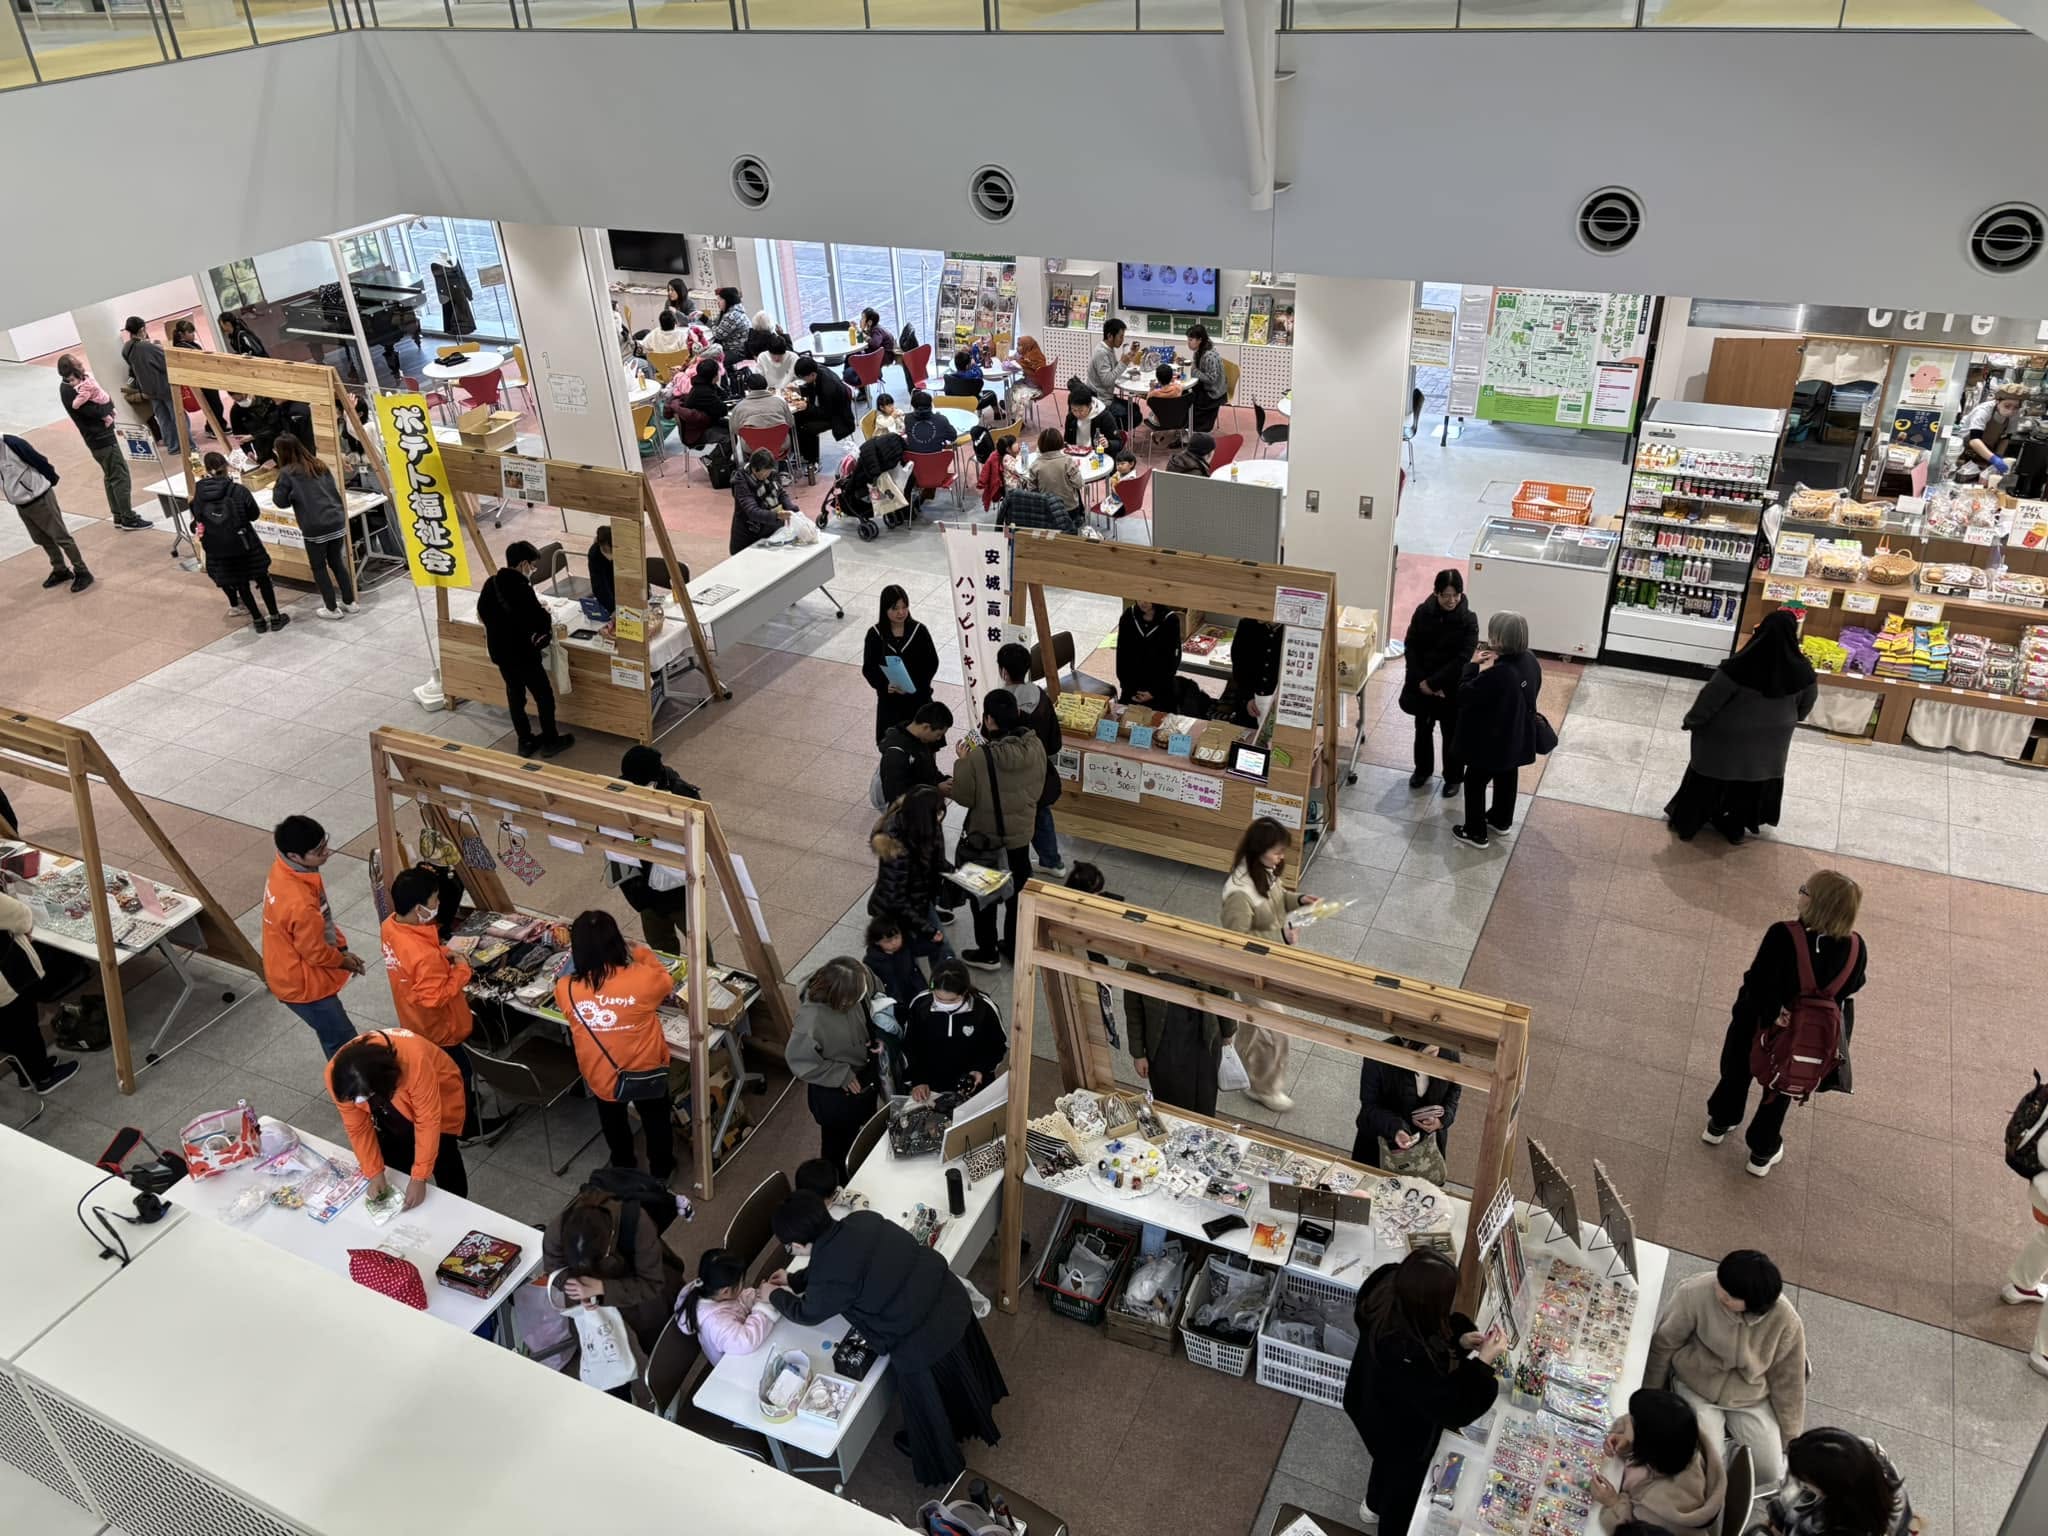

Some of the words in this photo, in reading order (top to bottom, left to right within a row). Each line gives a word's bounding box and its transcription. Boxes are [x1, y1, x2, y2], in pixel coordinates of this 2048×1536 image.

[391, 405, 456, 576] ポテト福祉会
[985, 549, 1001, 642] 安城高校
